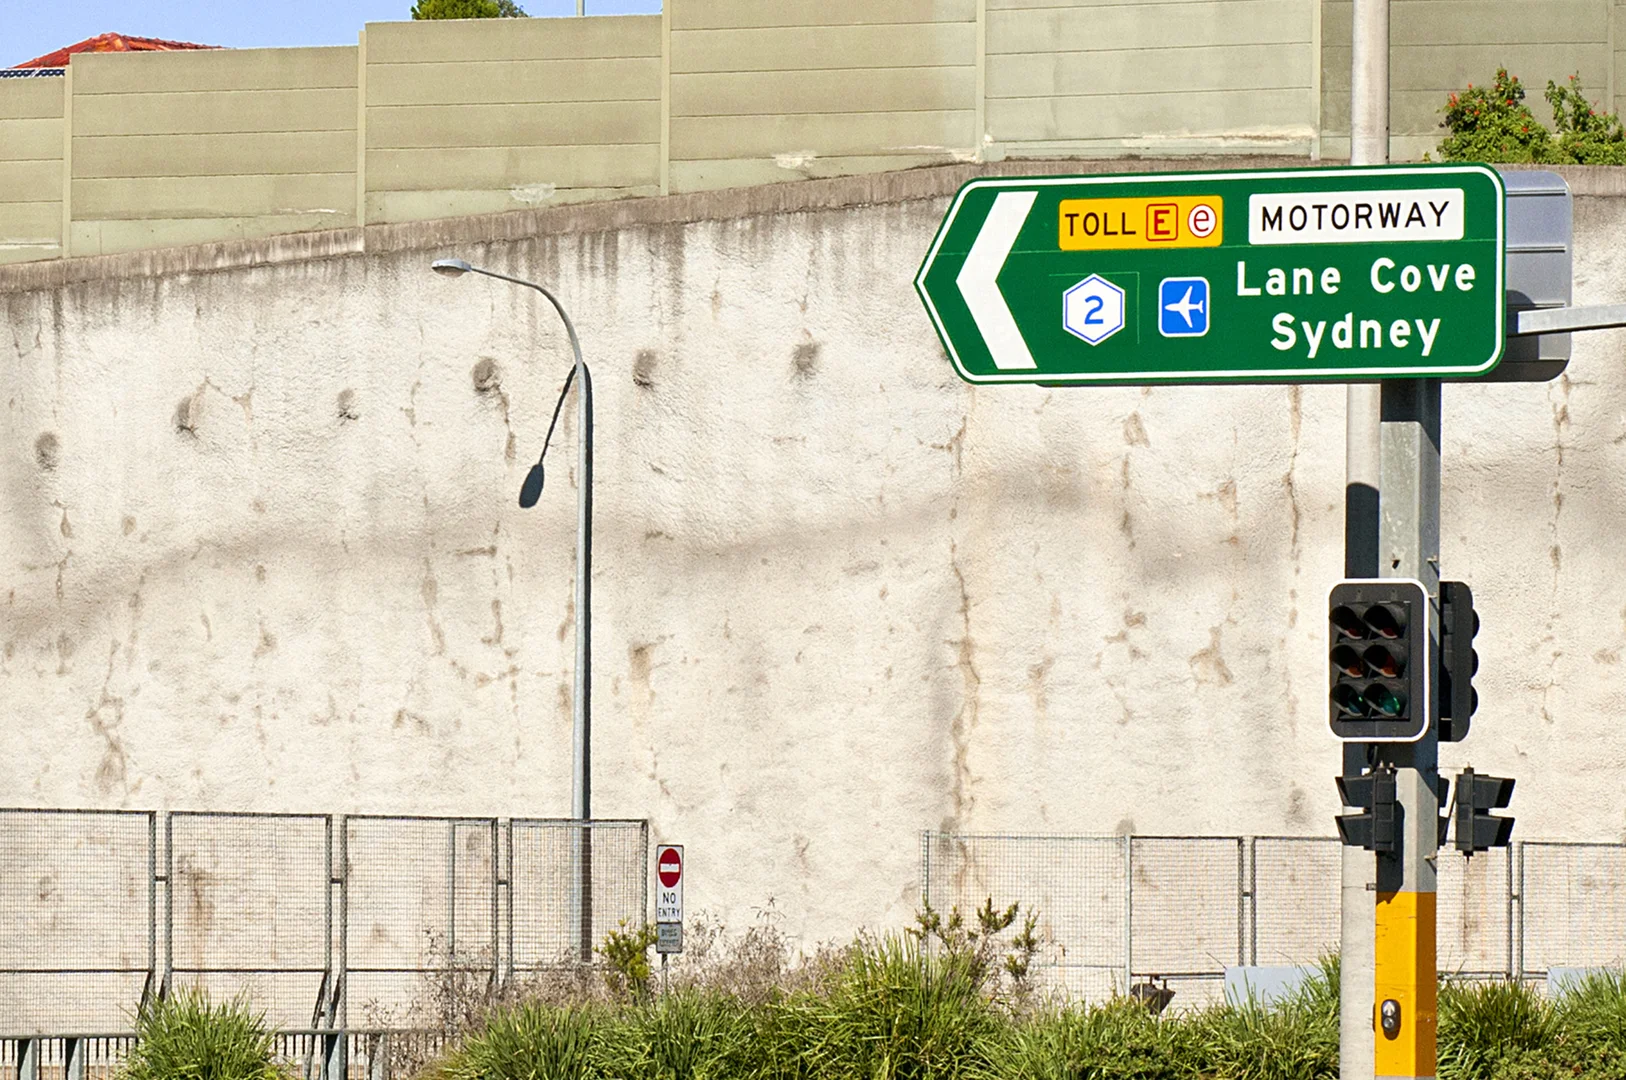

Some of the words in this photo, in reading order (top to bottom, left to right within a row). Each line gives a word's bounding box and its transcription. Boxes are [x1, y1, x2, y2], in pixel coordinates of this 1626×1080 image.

[1065, 212, 1136, 237] TOLL
[1153, 209, 1171, 236] E
[1262, 201, 1449, 231] MOTORWAY
[1237, 260, 1341, 297] Lane
[1370, 257, 1476, 293] Cove
[1084, 295, 1104, 325] 2
[1271, 312, 1441, 360] Sydney
[658, 907, 680, 917] ENTRY
[662, 892, 677, 904] NO
